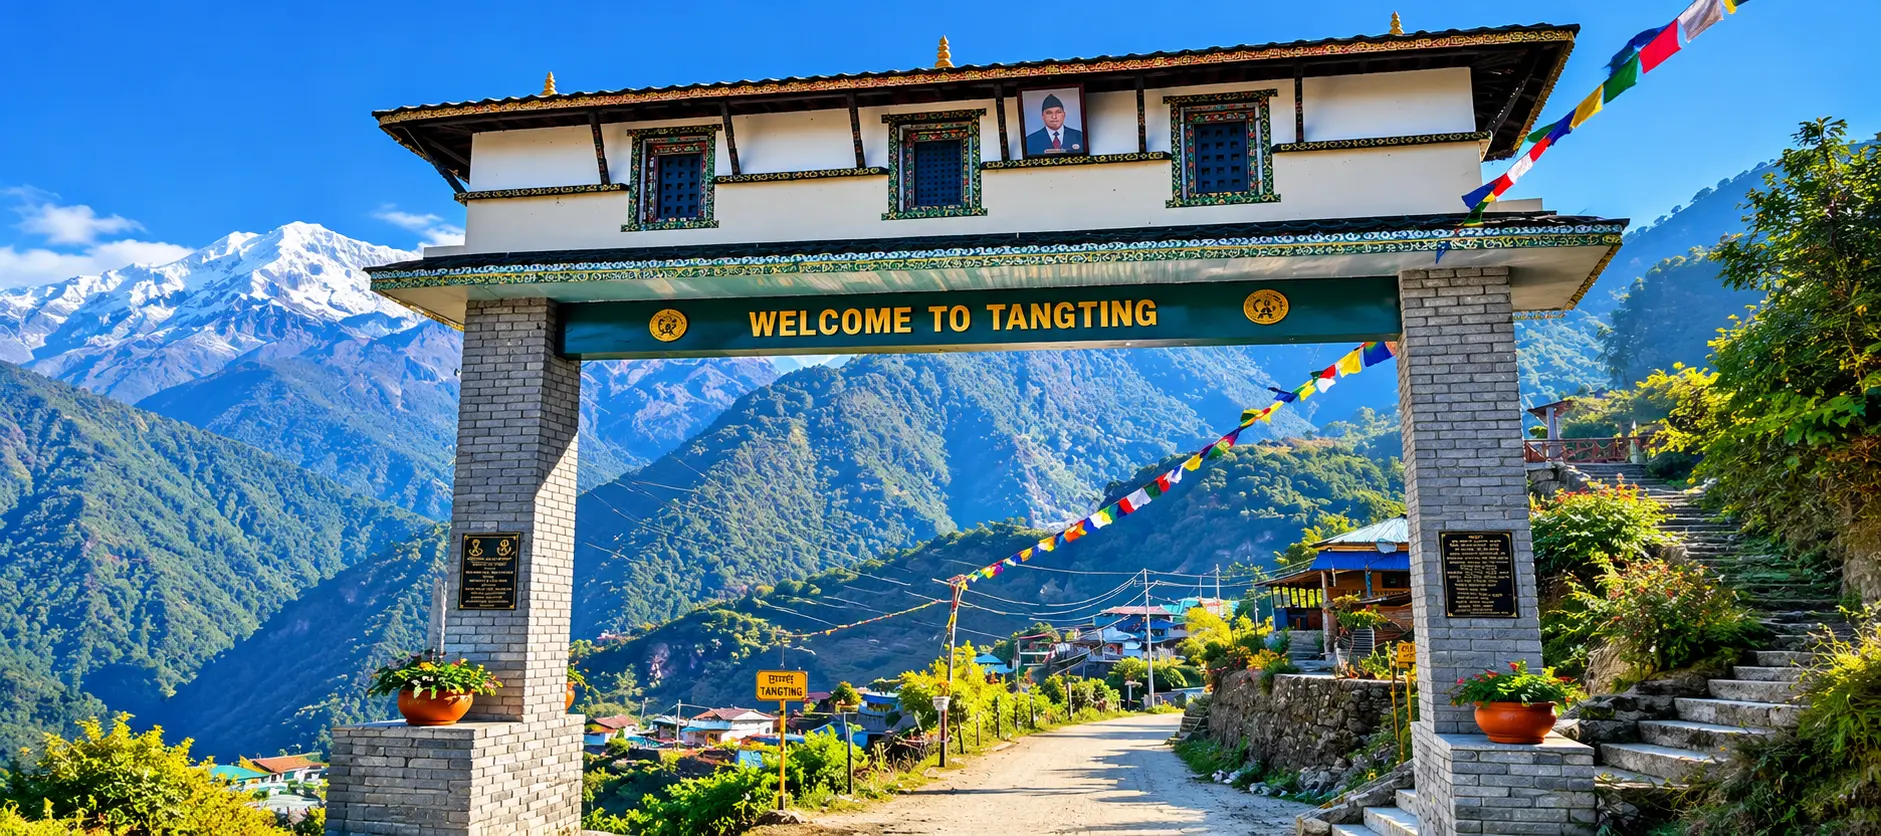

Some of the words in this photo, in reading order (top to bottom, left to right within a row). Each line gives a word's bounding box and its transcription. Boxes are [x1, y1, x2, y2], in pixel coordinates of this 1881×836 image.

[749, 306, 913, 337] WELCOME
[928, 304, 972, 332] TO
[986, 299, 1158, 331] TANGTING
[760, 686, 803, 697] TANGTING
